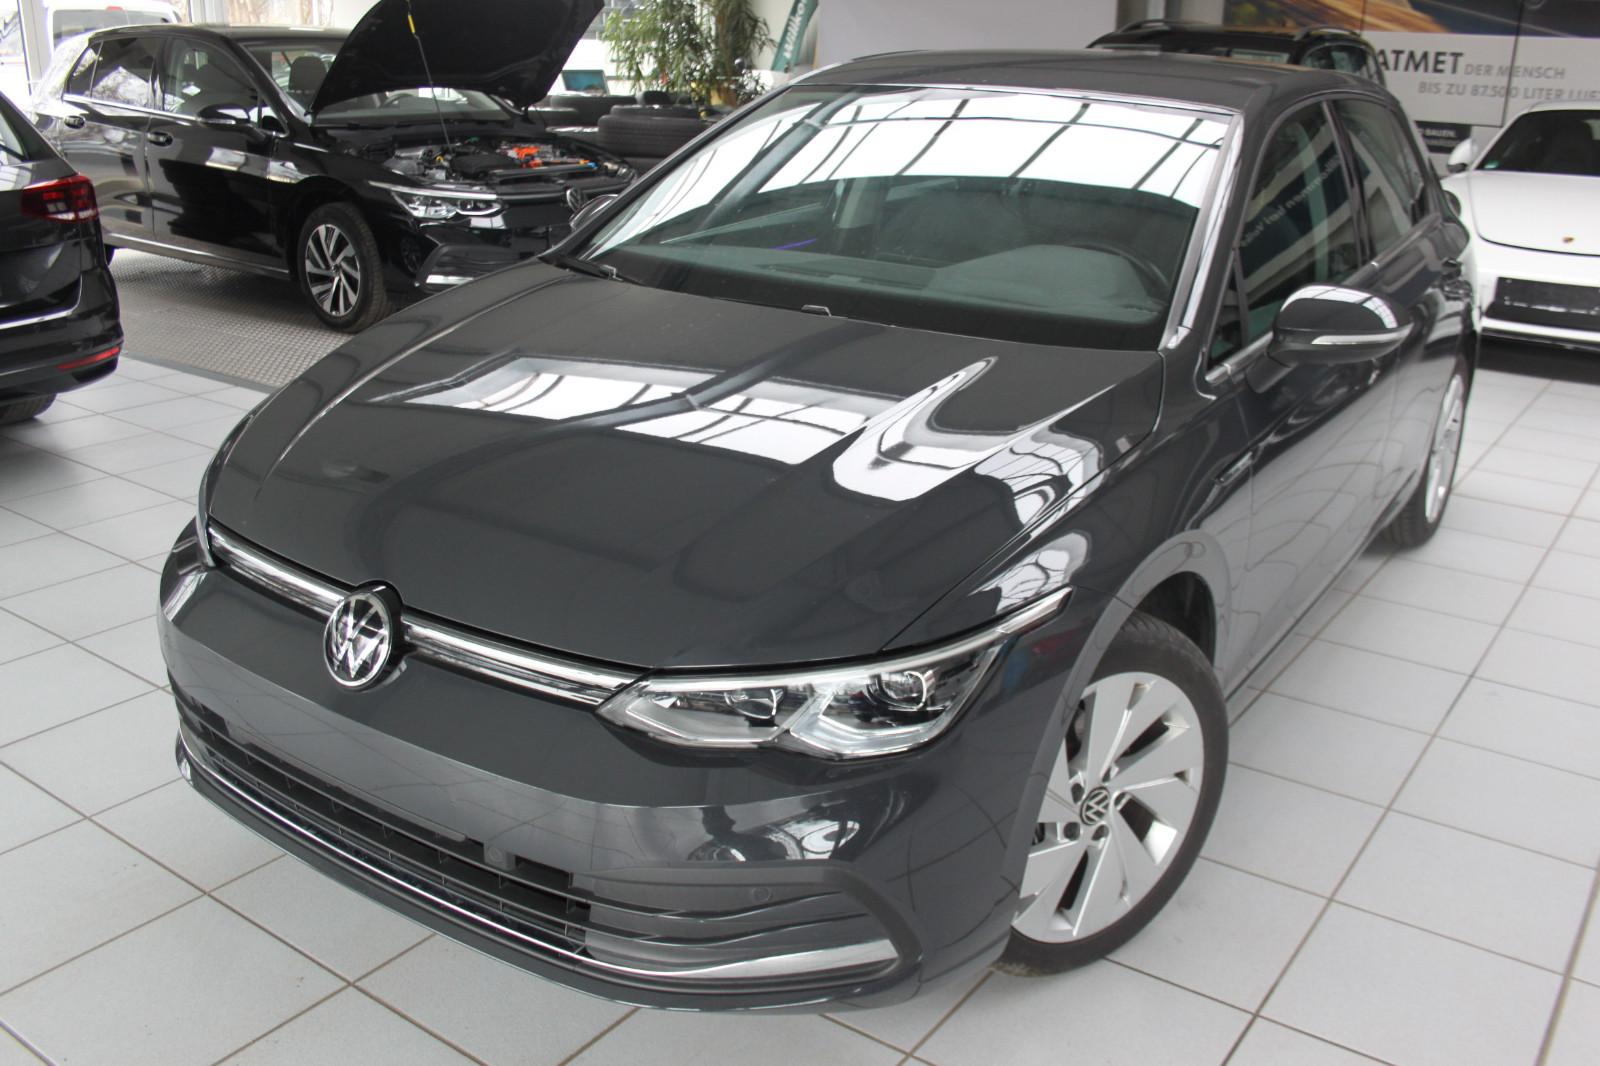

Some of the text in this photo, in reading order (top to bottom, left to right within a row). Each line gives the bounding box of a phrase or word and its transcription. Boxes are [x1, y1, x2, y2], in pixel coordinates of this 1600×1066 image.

[1463, 63, 1493, 76] DER
[1496, 65, 1566, 79] MENSCH
[1418, 81, 1441, 94] BIS
[1445, 83, 1467, 96] ZU
[324, 593, 391, 687] VW
